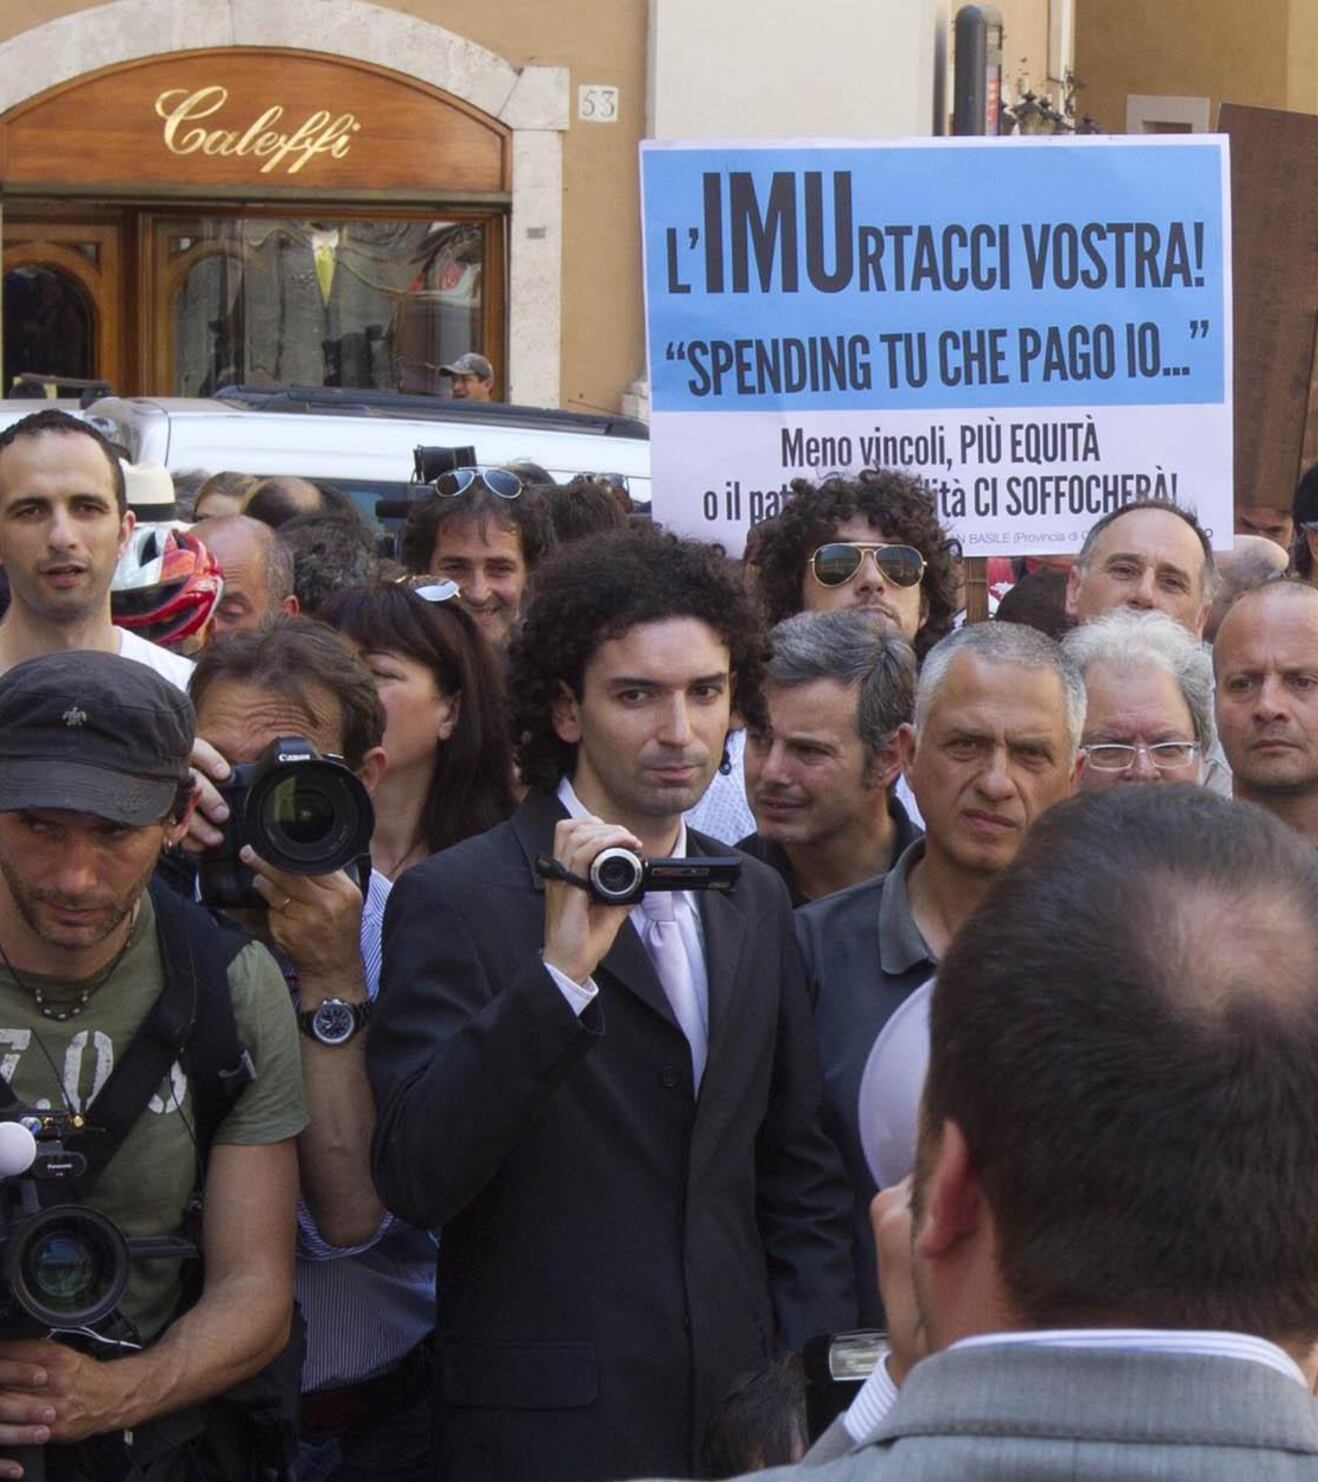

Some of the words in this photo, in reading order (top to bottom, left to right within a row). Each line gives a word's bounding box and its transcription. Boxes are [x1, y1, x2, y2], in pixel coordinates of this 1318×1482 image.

[155, 86, 361, 174] Caleffi
[582, 90, 616, 118] 53
[1022, 221, 1205, 290] VOSTRA!
[879, 332, 928, 389] TU
[939, 329, 1010, 387] CHE
[1018, 323, 1115, 384] PAGO
[781, 427, 852, 468] Meno
[859, 425, 952, 471] vincoli,
[960, 416, 1001, 464] PIÙ
[1010, 414, 1100, 465] EQUITÀ
[704, 490, 718, 526] o
[726, 481, 740, 526] il
[974, 477, 998, 516] CI
[969, 532, 1011, 545] BASILE
[1013, 531, 1067, 546] (Provincia
[1069, 530, 1078, 542] di
